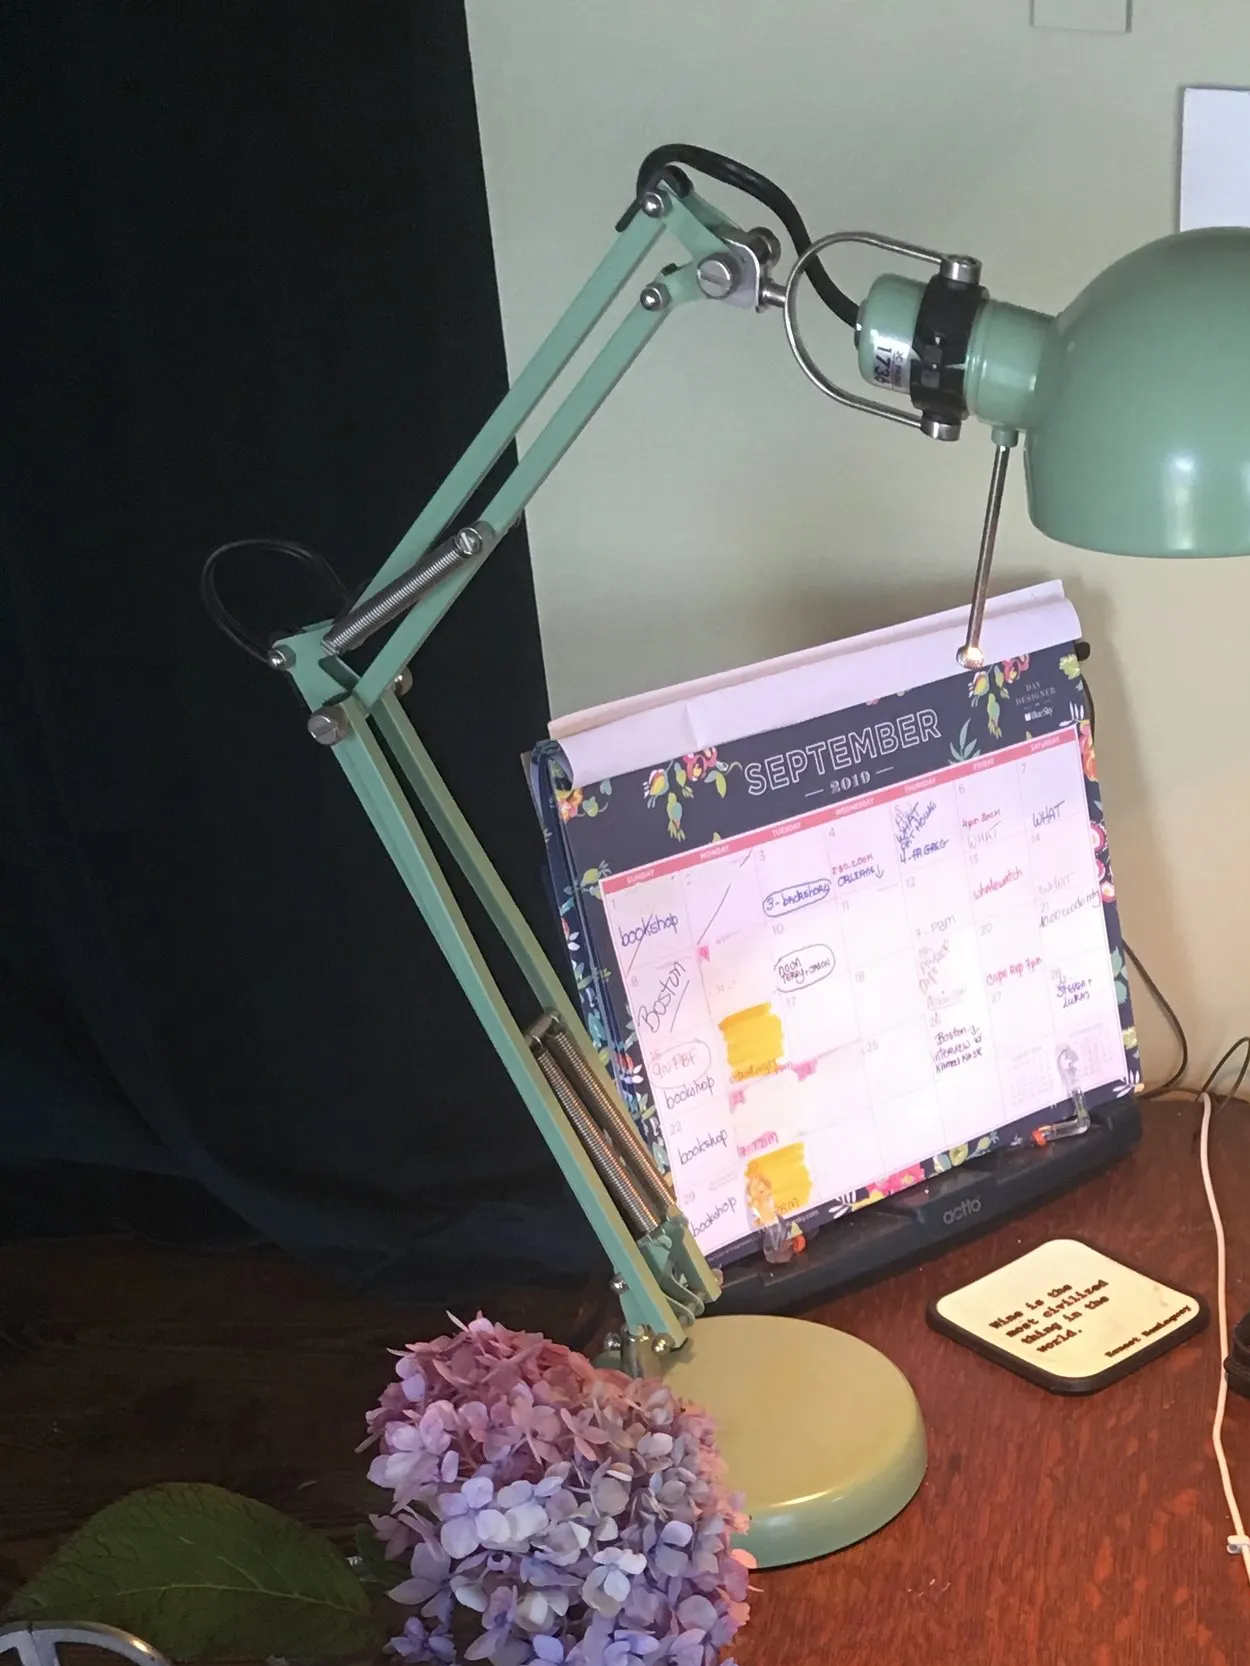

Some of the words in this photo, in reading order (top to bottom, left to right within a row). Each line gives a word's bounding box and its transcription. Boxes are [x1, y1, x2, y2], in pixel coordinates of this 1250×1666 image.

[1015, 686, 1057, 706] DESIGNER
[1025, 681, 1042, 693] DAY
[744, 708, 942, 796] SEPTEMBER
[829, 770, 871, 795] 2019
[625, 867, 656, 885] SUNDAY
[700, 844, 730, 860] MONDAY
[771, 822, 802, 838] TUESDAY
[834, 796, 875, 816] WEDNESDAY
[904, 777, 937, 794] THURSDAY
[972, 758, 995, 771] FRIDAY
[1029, 736, 1061, 752] SATURDAY
[1031, 800, 1066, 828] WHAT
[663, 1074, 715, 1110] bookshop
[677, 1128, 728, 1166] bookshop
[988, 1311, 1024, 1330] Wine
[1025, 1298, 1045, 1310] is
[1046, 1284, 1073, 1298] the
[1005, 1318, 1040, 1337] most
[1042, 1279, 1109, 1318] civilized
[1020, 1322, 1063, 1344] thing
[1062, 1310, 1083, 1322] in
[1083, 1296, 1110, 1310] the
